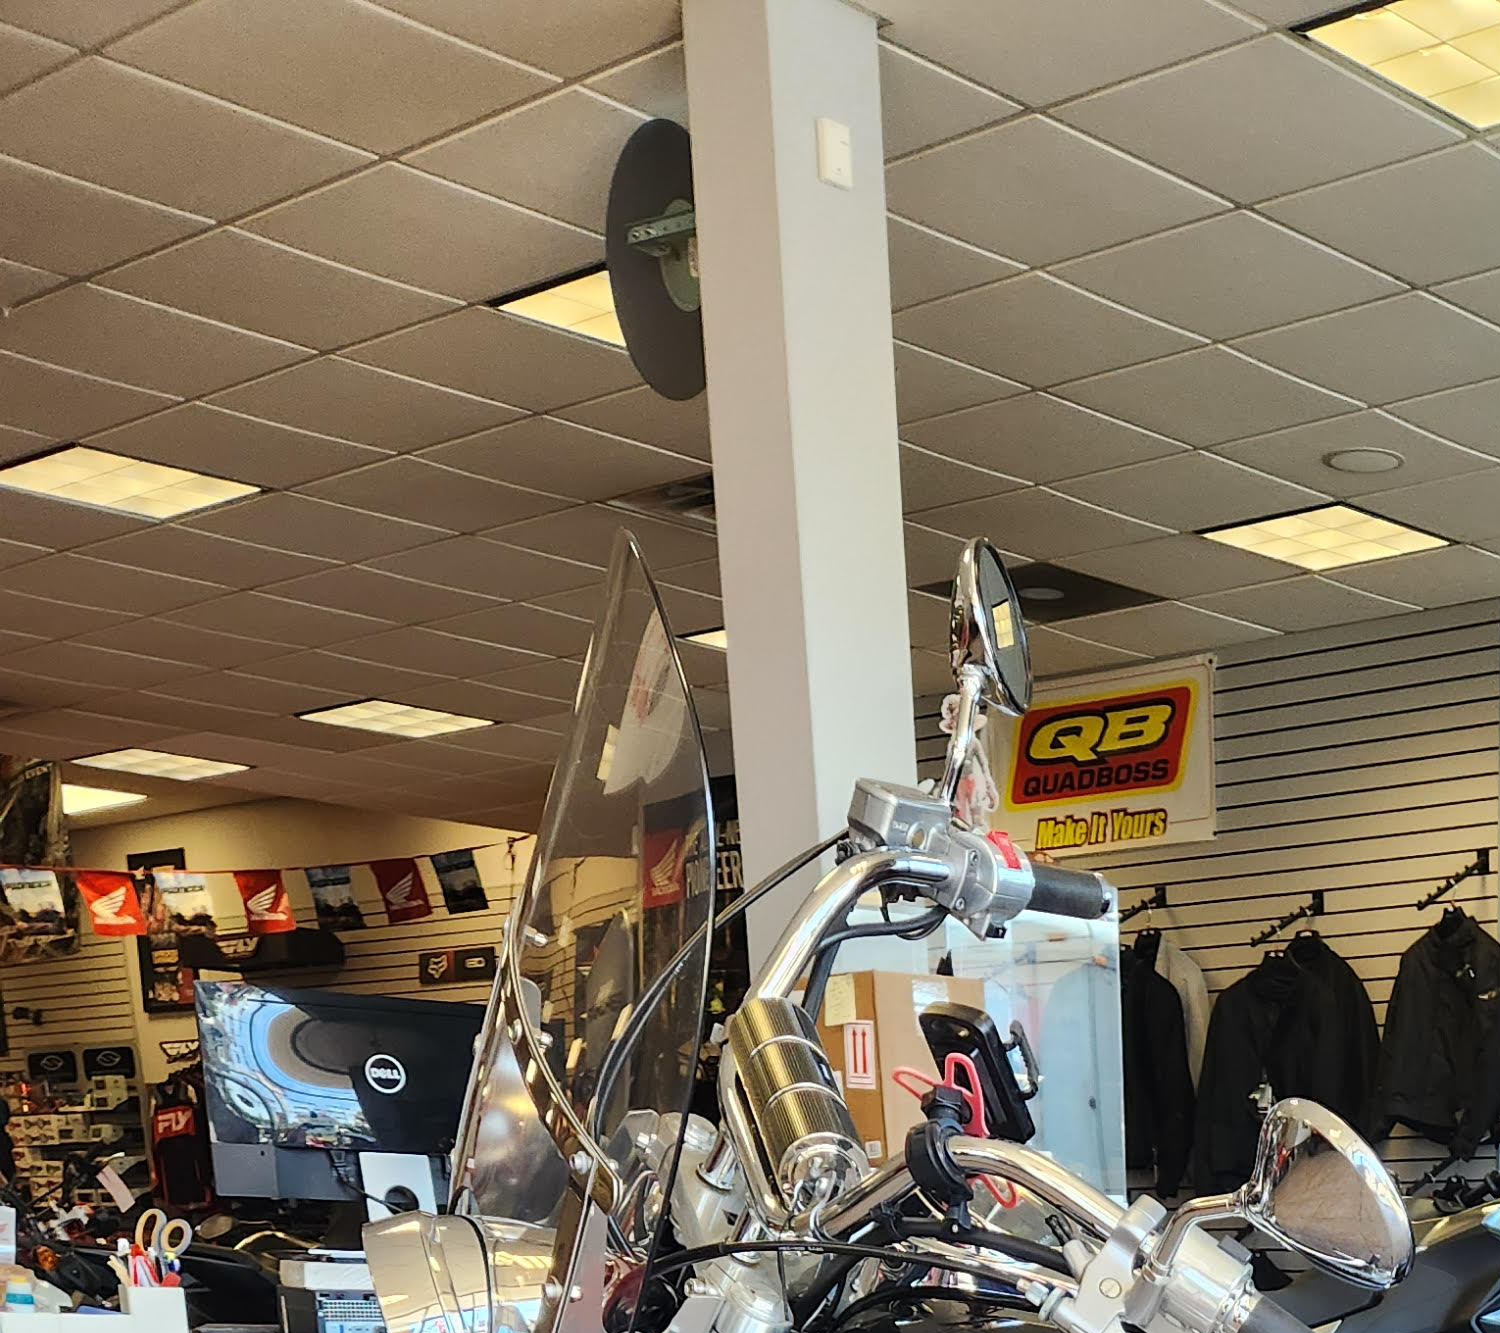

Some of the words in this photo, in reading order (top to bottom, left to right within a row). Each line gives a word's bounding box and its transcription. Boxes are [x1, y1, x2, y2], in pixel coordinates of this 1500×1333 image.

[1027, 701, 1174, 763] QB
[1023, 758, 1170, 798] QUADBOSS
[1036, 818, 1088, 850] Make
[1090, 811, 1106, 844] It
[1112, 808, 1168, 841] Yours
[370, 1067, 401, 1080] DELL
[158, 1110, 192, 1134] FLY
